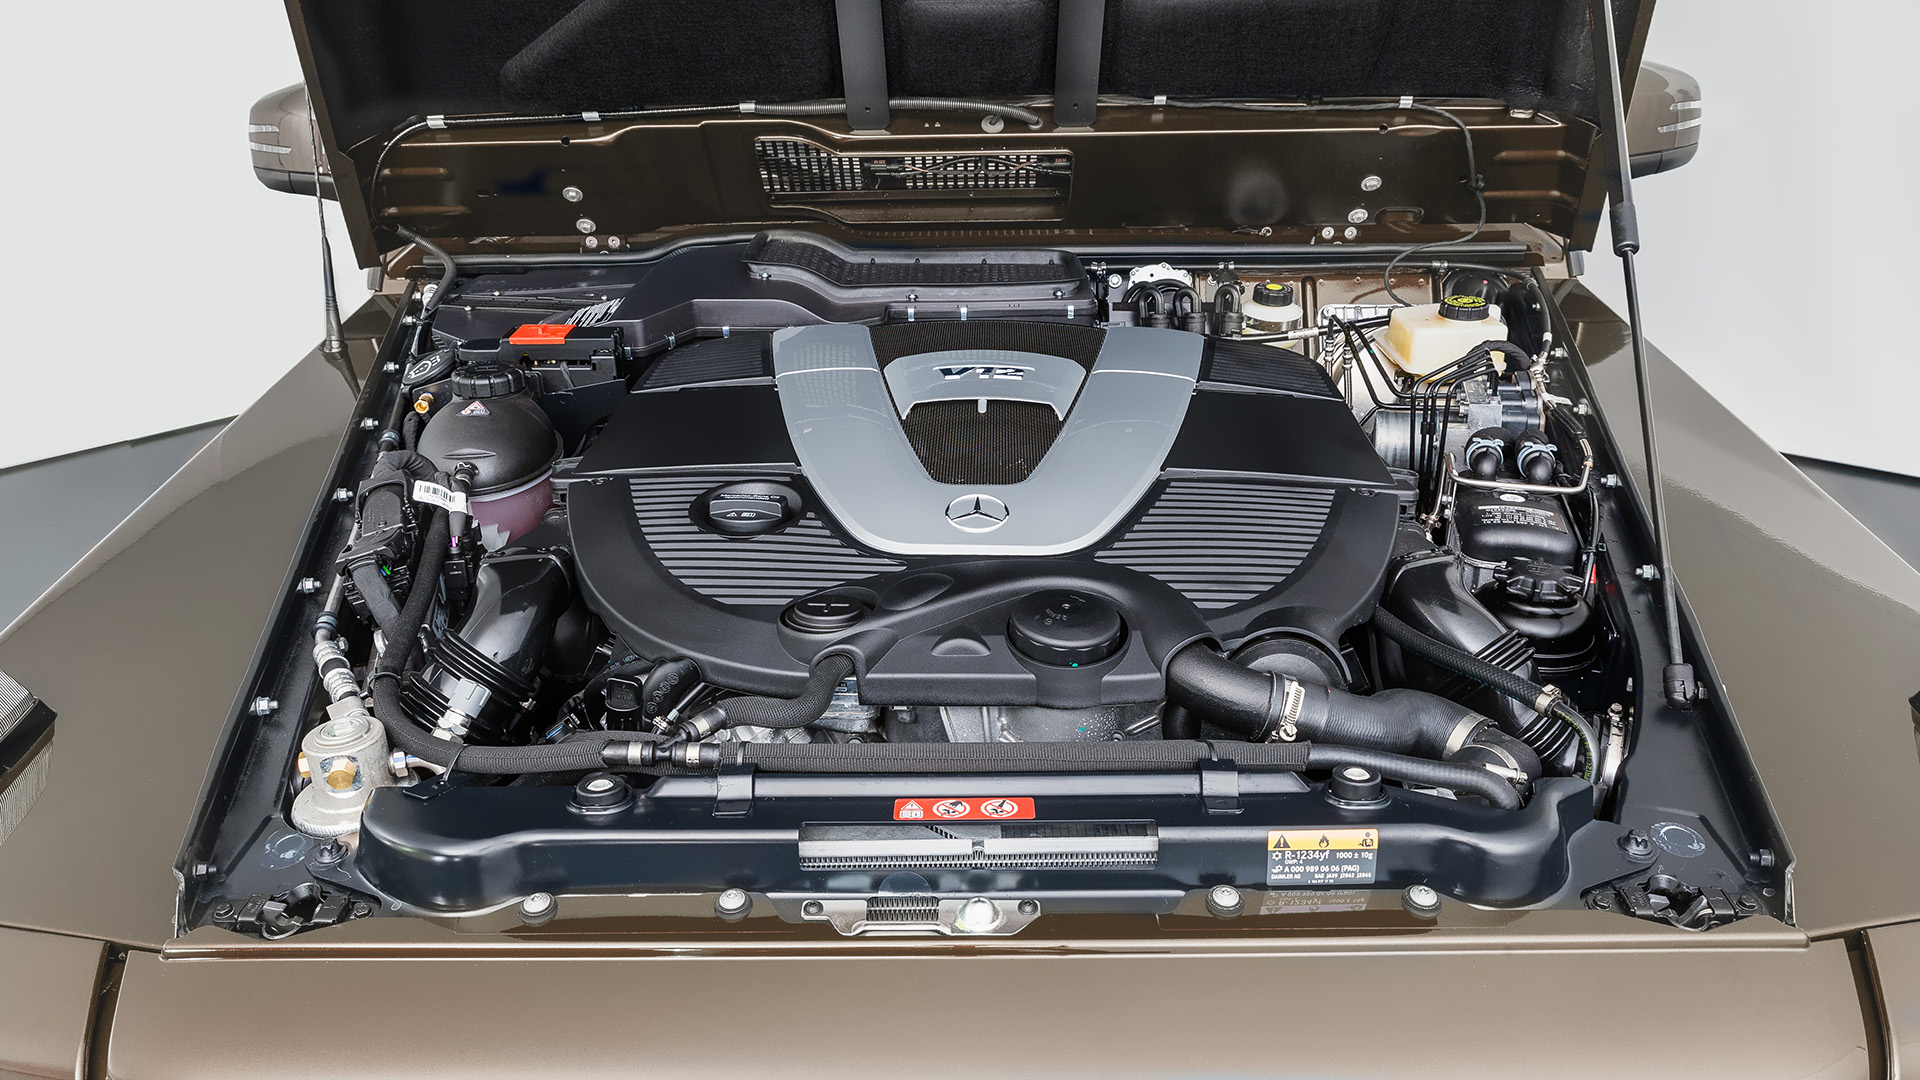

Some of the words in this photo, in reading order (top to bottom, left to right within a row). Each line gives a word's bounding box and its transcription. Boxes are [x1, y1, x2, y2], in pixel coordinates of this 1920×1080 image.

[939, 366, 1025, 380] V12
[1284, 850, 1330, 861] R-1234yf
[1336, 851, 1353, 859] 1000
[1361, 851, 1373, 860] 10g
[1290, 865, 1304, 873] 000
[1341, 864, 1360, 873] (PAG)
